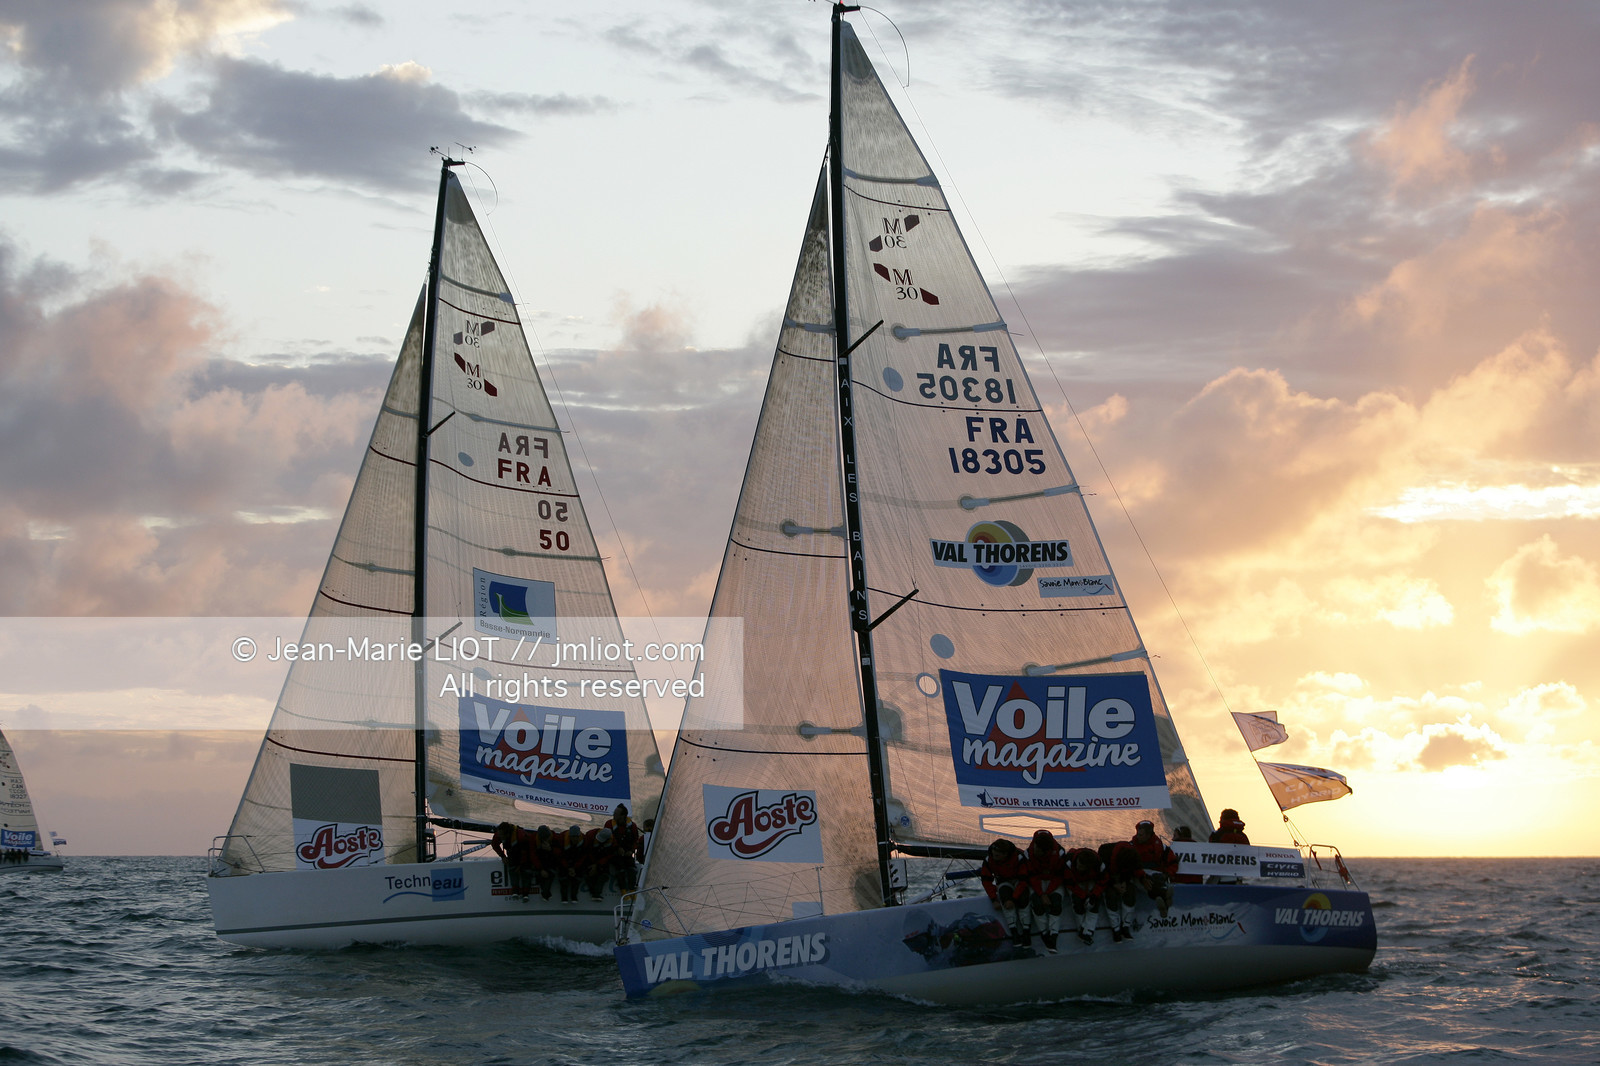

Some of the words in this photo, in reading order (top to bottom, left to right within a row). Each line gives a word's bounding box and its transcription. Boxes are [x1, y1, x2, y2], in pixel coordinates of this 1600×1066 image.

[892, 268, 913, 286] M
[896, 286, 918, 300] 30
[466, 362, 481, 378] M
[467, 378, 482, 390] 30
[840, 378, 853, 427] AIX
[966, 416, 1034, 444] FRA
[498, 458, 552, 487] FRA
[948, 448, 1046, 475] 18305
[847, 454, 858, 502] LES
[540, 530, 570, 551] 50
[932, 541, 968, 562] VAL
[974, 542, 1068, 564] THORENS
[852, 531, 868, 620] BAINS
[1040, 579, 1062, 588] Savoie
[480, 620, 551, 638] Basse-Normandie
[952, 680, 1136, 740] Voile
[474, 702, 612, 759] Voile
[476, 745, 613, 786] magazine
[962, 736, 1141, 785] magazine
[495, 788, 516, 798] TOUR
[526, 794, 554, 804] FRANCE
[566, 800, 588, 810] VOILE
[590, 803, 608, 812] 2007
[994, 796, 1020, 806] TOUR
[1032, 798, 1070, 807] FRANCE
[1086, 798, 1114, 807] VOILE
[1116, 796, 1140, 806] 2007
[712, 794, 814, 842] Aoste
[4, 831, 32, 842] Voile
[299, 826, 382, 861] Aoste
[1176, 852, 1198, 865] VAL
[1200, 853, 1257, 866] THORENS
[1266, 862, 1298, 870] CIVIC
[385, 874, 463, 890] Techneau
[1147, 915, 1178, 929] Savoie
[1209, 912, 1236, 925] Blanc
[1275, 908, 1299, 925] VAL
[1302, 908, 1366, 927] THORENS
[644, 951, 692, 984] VAL
[702, 932, 826, 977] THORENS
